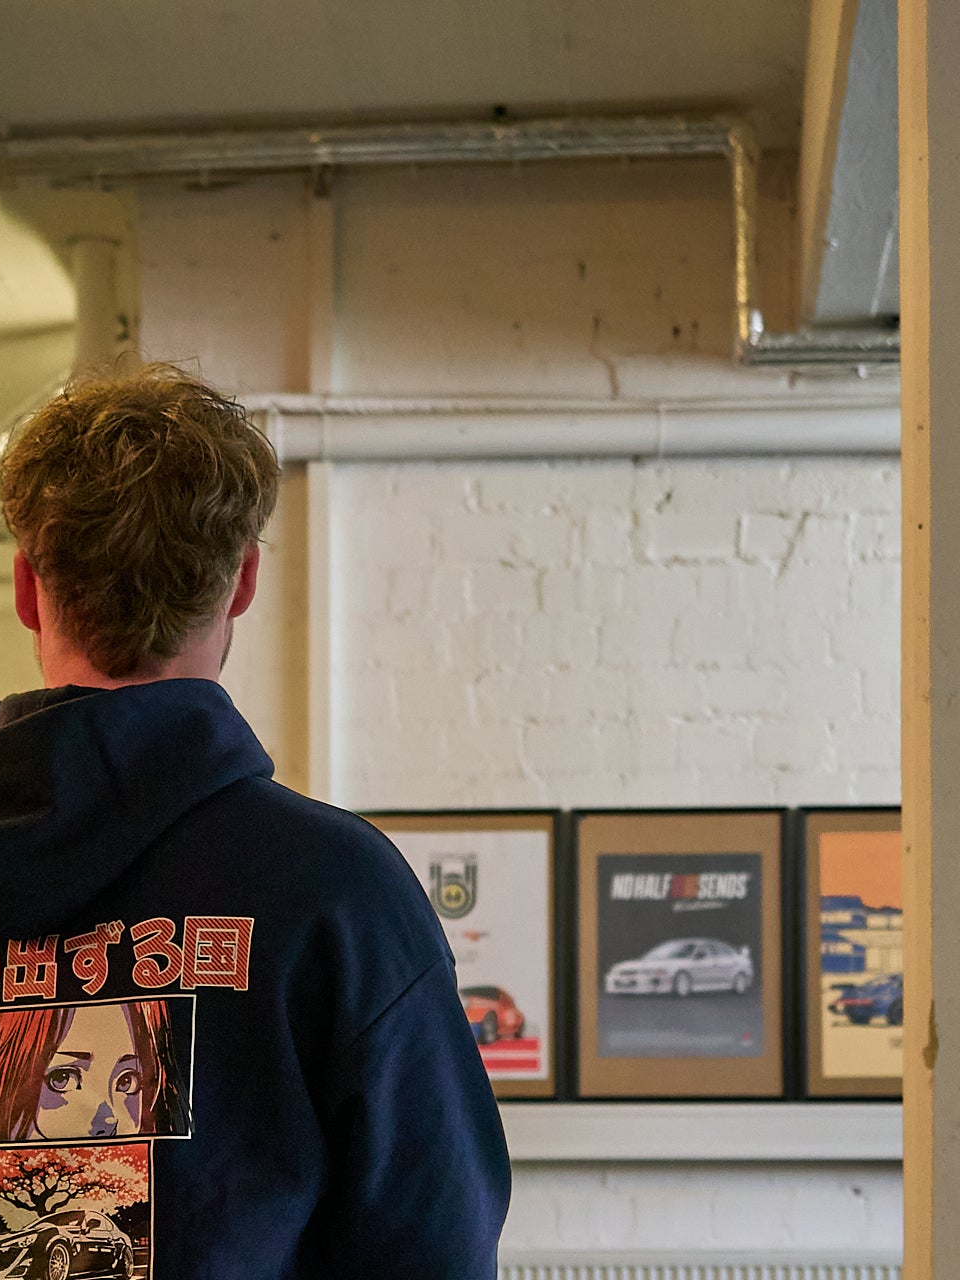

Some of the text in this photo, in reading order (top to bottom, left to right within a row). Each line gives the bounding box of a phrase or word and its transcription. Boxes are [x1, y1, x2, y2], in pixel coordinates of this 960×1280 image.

[612, 873, 748, 898] NO HALF SENDS
